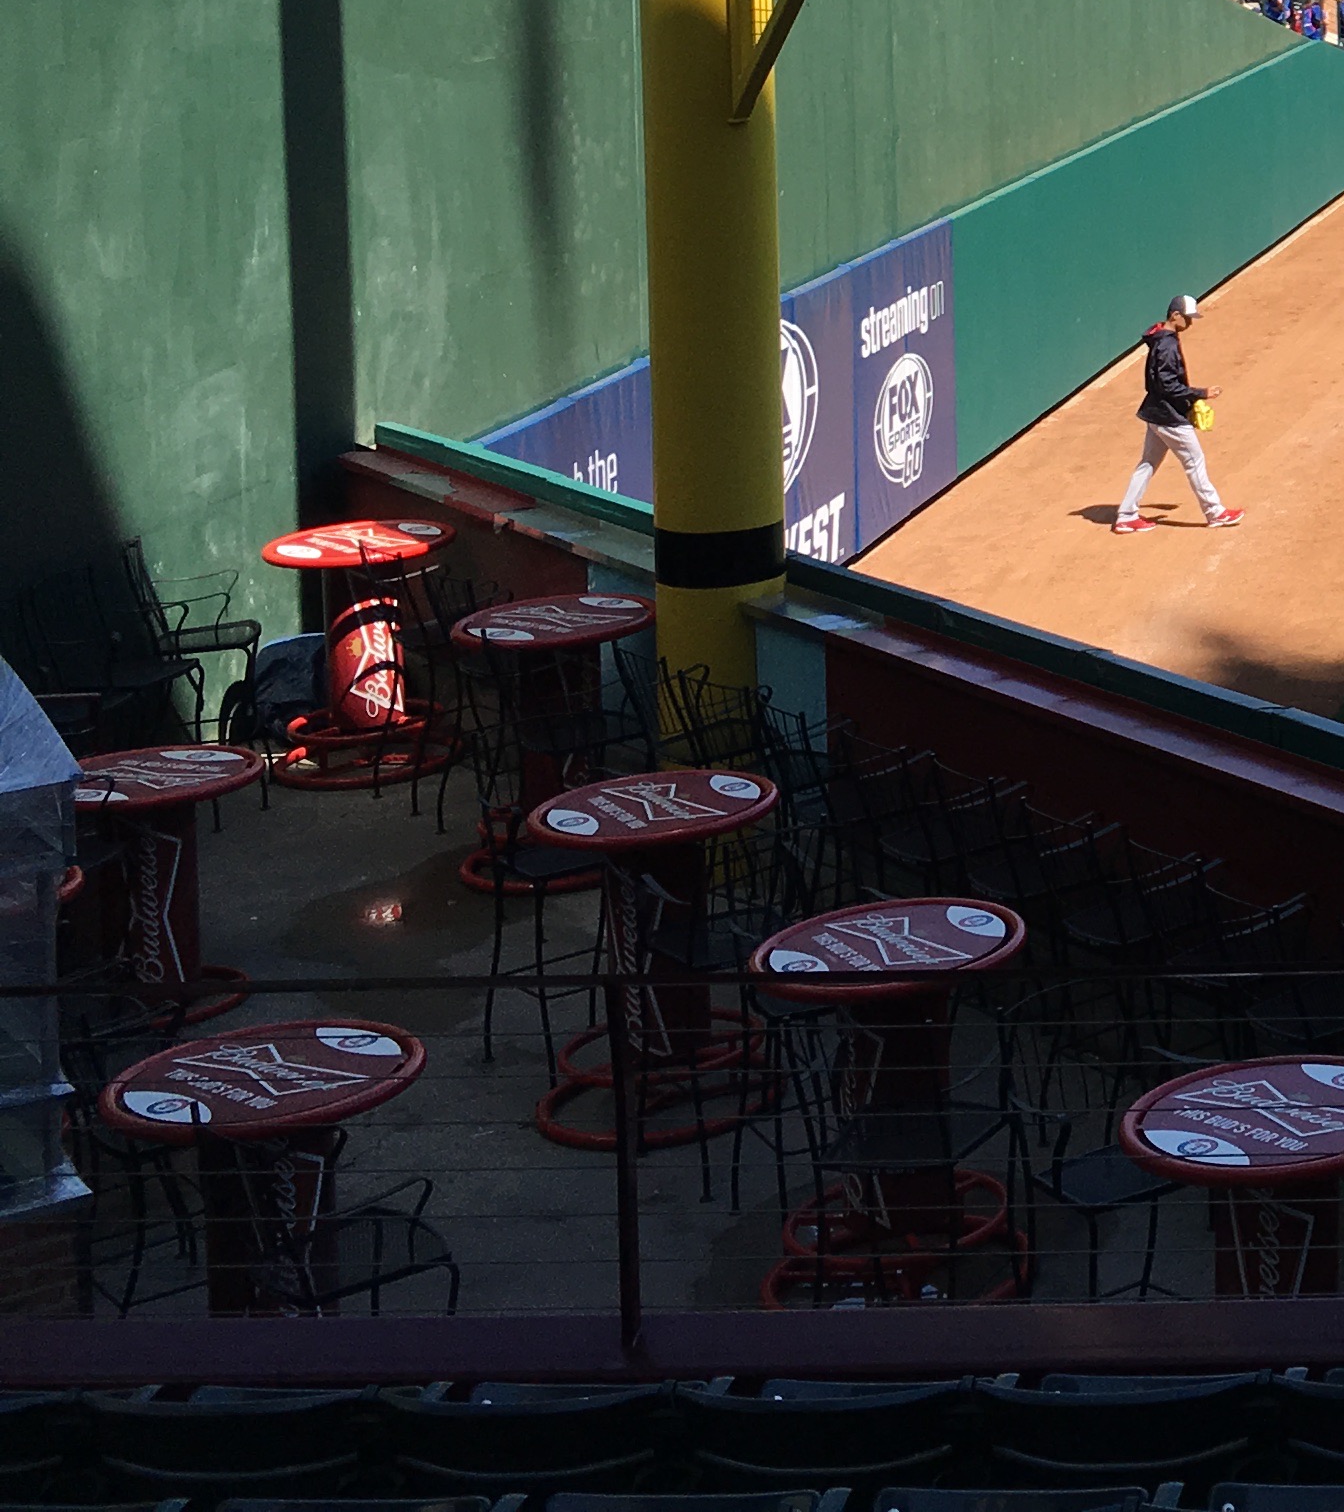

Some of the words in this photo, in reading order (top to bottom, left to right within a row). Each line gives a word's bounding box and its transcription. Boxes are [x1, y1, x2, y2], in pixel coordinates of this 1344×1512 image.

[861, 286, 928, 358] streaming
[929, 280, 944, 321] on
[887, 370, 920, 435] FOX
[888, 417, 920, 454] SPORTS
[588, 449, 618, 494] the
[903, 441, 923, 488] GO
